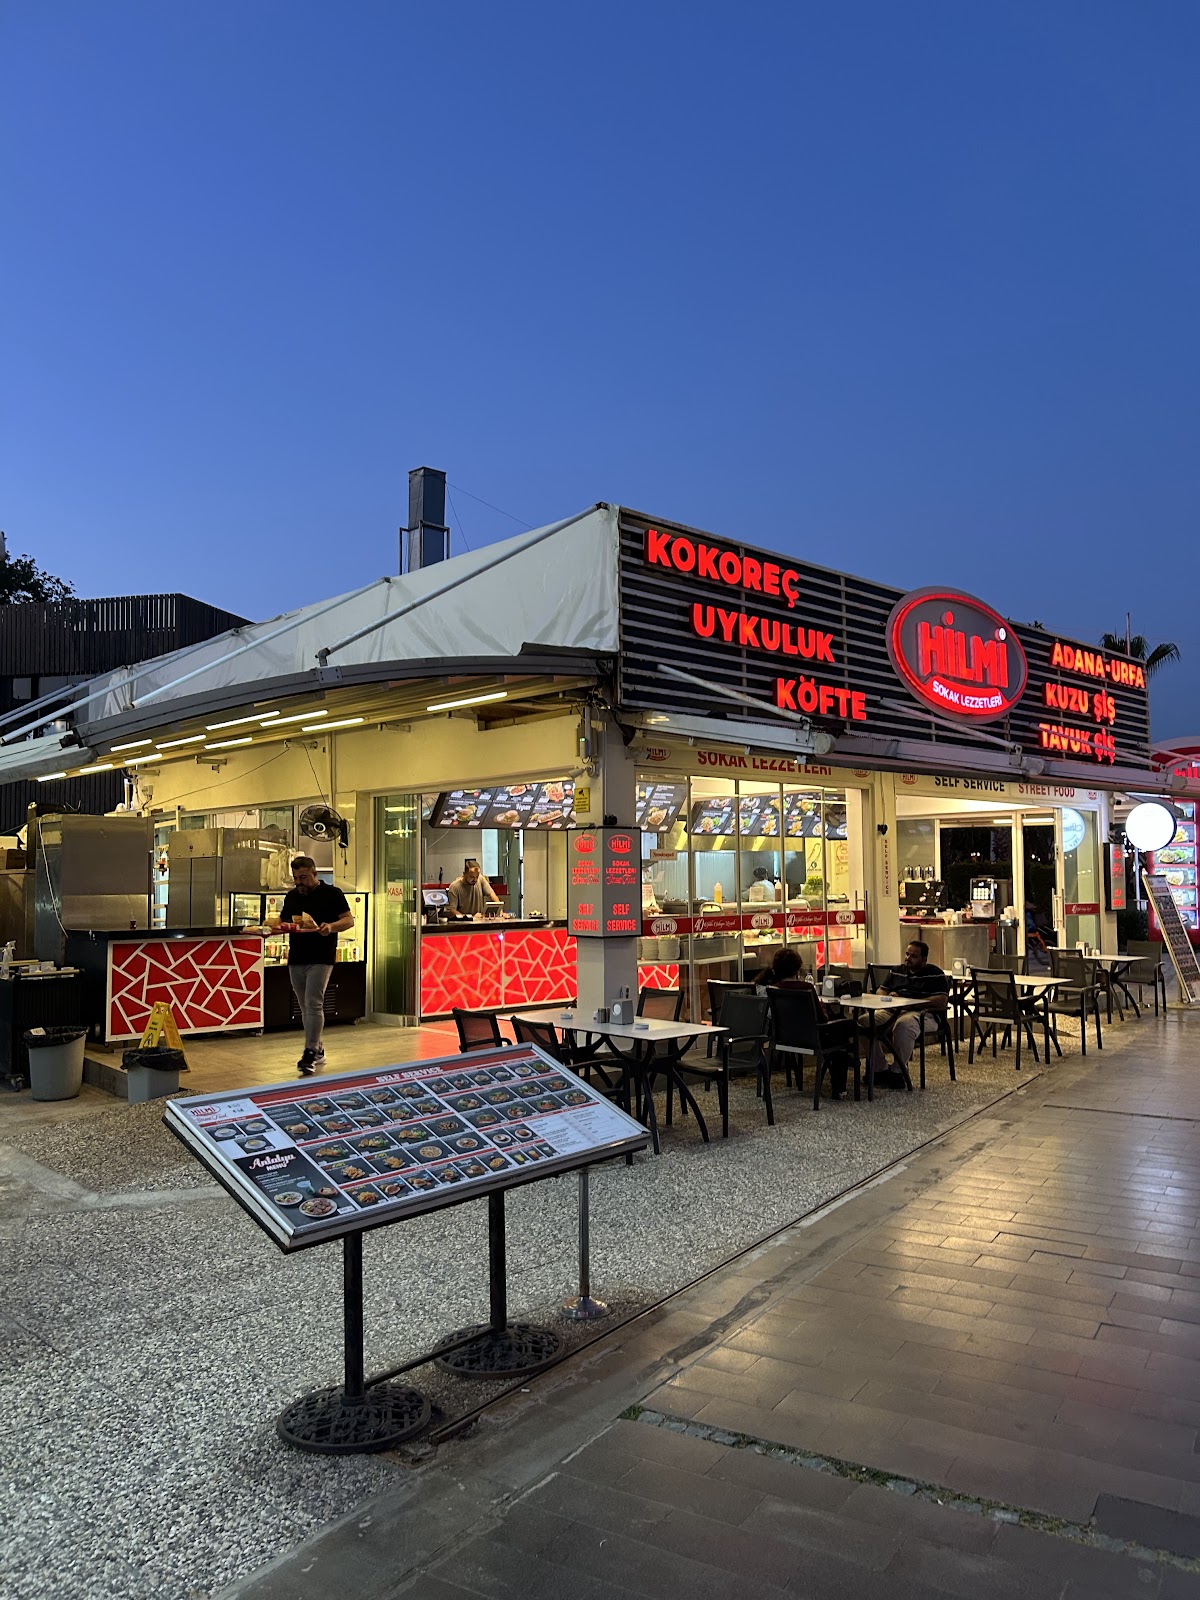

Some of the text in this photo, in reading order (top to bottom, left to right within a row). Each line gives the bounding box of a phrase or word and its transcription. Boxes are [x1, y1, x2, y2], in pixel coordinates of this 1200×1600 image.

[646, 529, 800, 608] KOKOREÇ
[691, 603, 836, 663] UYKULUK
[1051, 642, 1146, 689] ADANA-URFA
[775, 675, 867, 721] KÖFTE
[932, 680, 960, 705] SOKAK
[1045, 682, 1116, 726] KUZU ŞİŞ
[1039, 722, 1092, 755] TAVUK
[697, 751, 748, 768] SOKAK
[934, 774, 1005, 792] SELF SERVICE
[1018, 783, 1050, 797] STREET
[1054, 786, 1075, 798] FOOD
[388, 887, 403, 896] KASA
[578, 903, 593, 915] SELF
[613, 903, 630, 915] SELF
[607, 919, 637, 931] SERVICE
[376, 1073, 400, 1083] SELF
[401, 1066, 443, 1079] SERVICE
[249, 1153, 297, 1169] Antalya
